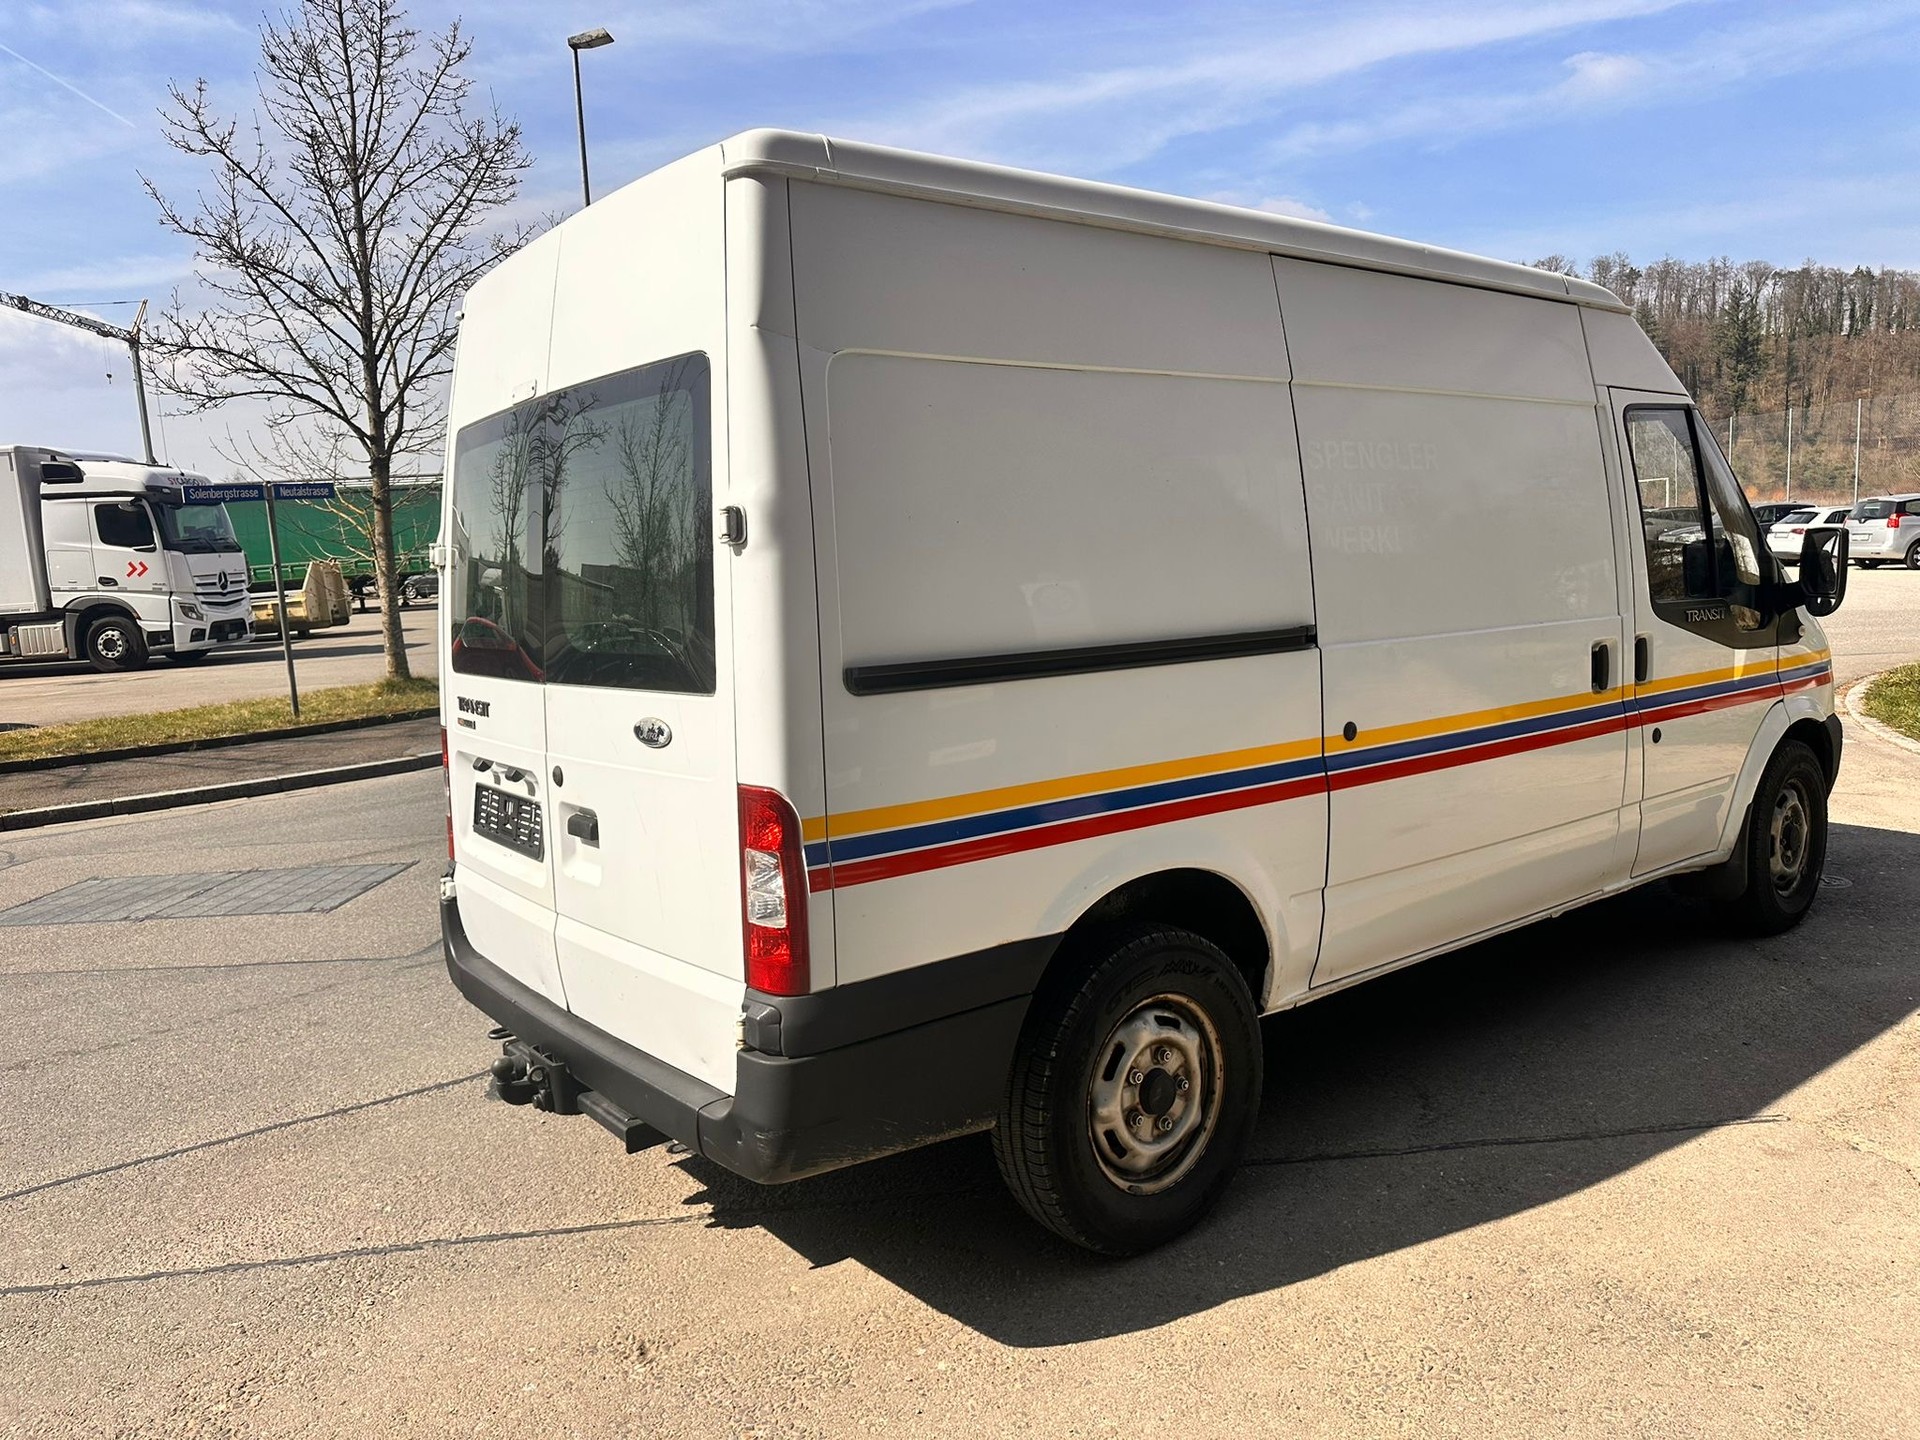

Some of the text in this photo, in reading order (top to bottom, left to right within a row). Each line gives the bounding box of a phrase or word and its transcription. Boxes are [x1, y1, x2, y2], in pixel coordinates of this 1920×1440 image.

[1307, 440, 1439, 471] SPENGLER
[189, 487, 259, 501] Solenbergstrasse
[280, 485, 330, 497] Neutalstrasse
[1685, 608, 1725, 622] TRANSIT
